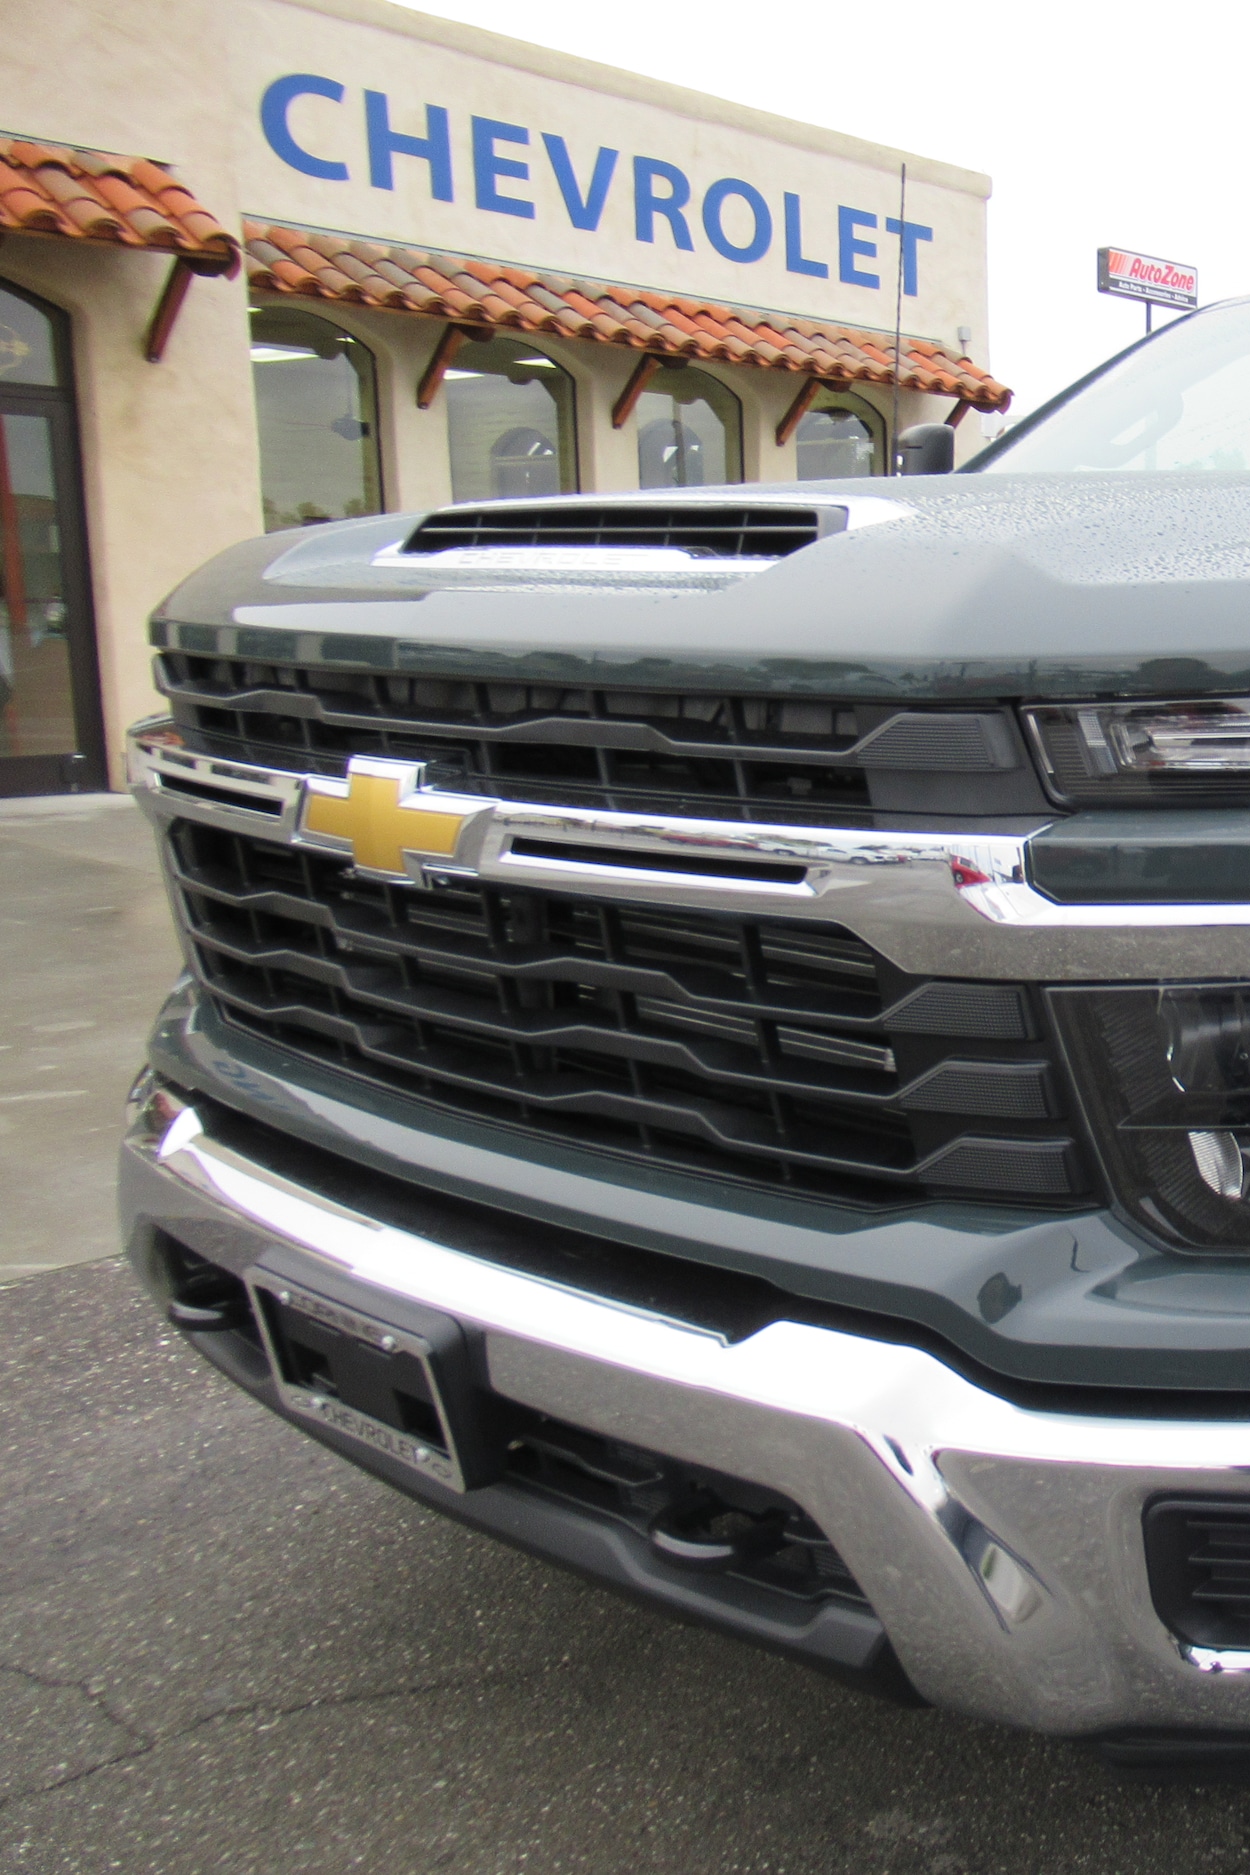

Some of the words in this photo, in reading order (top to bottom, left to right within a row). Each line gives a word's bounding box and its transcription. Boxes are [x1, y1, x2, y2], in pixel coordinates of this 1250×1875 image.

[261, 74, 932, 297] CHEVROLET
[1129, 257, 1195, 291] AutoZone
[457, 552, 650, 566] CHEVROLET
